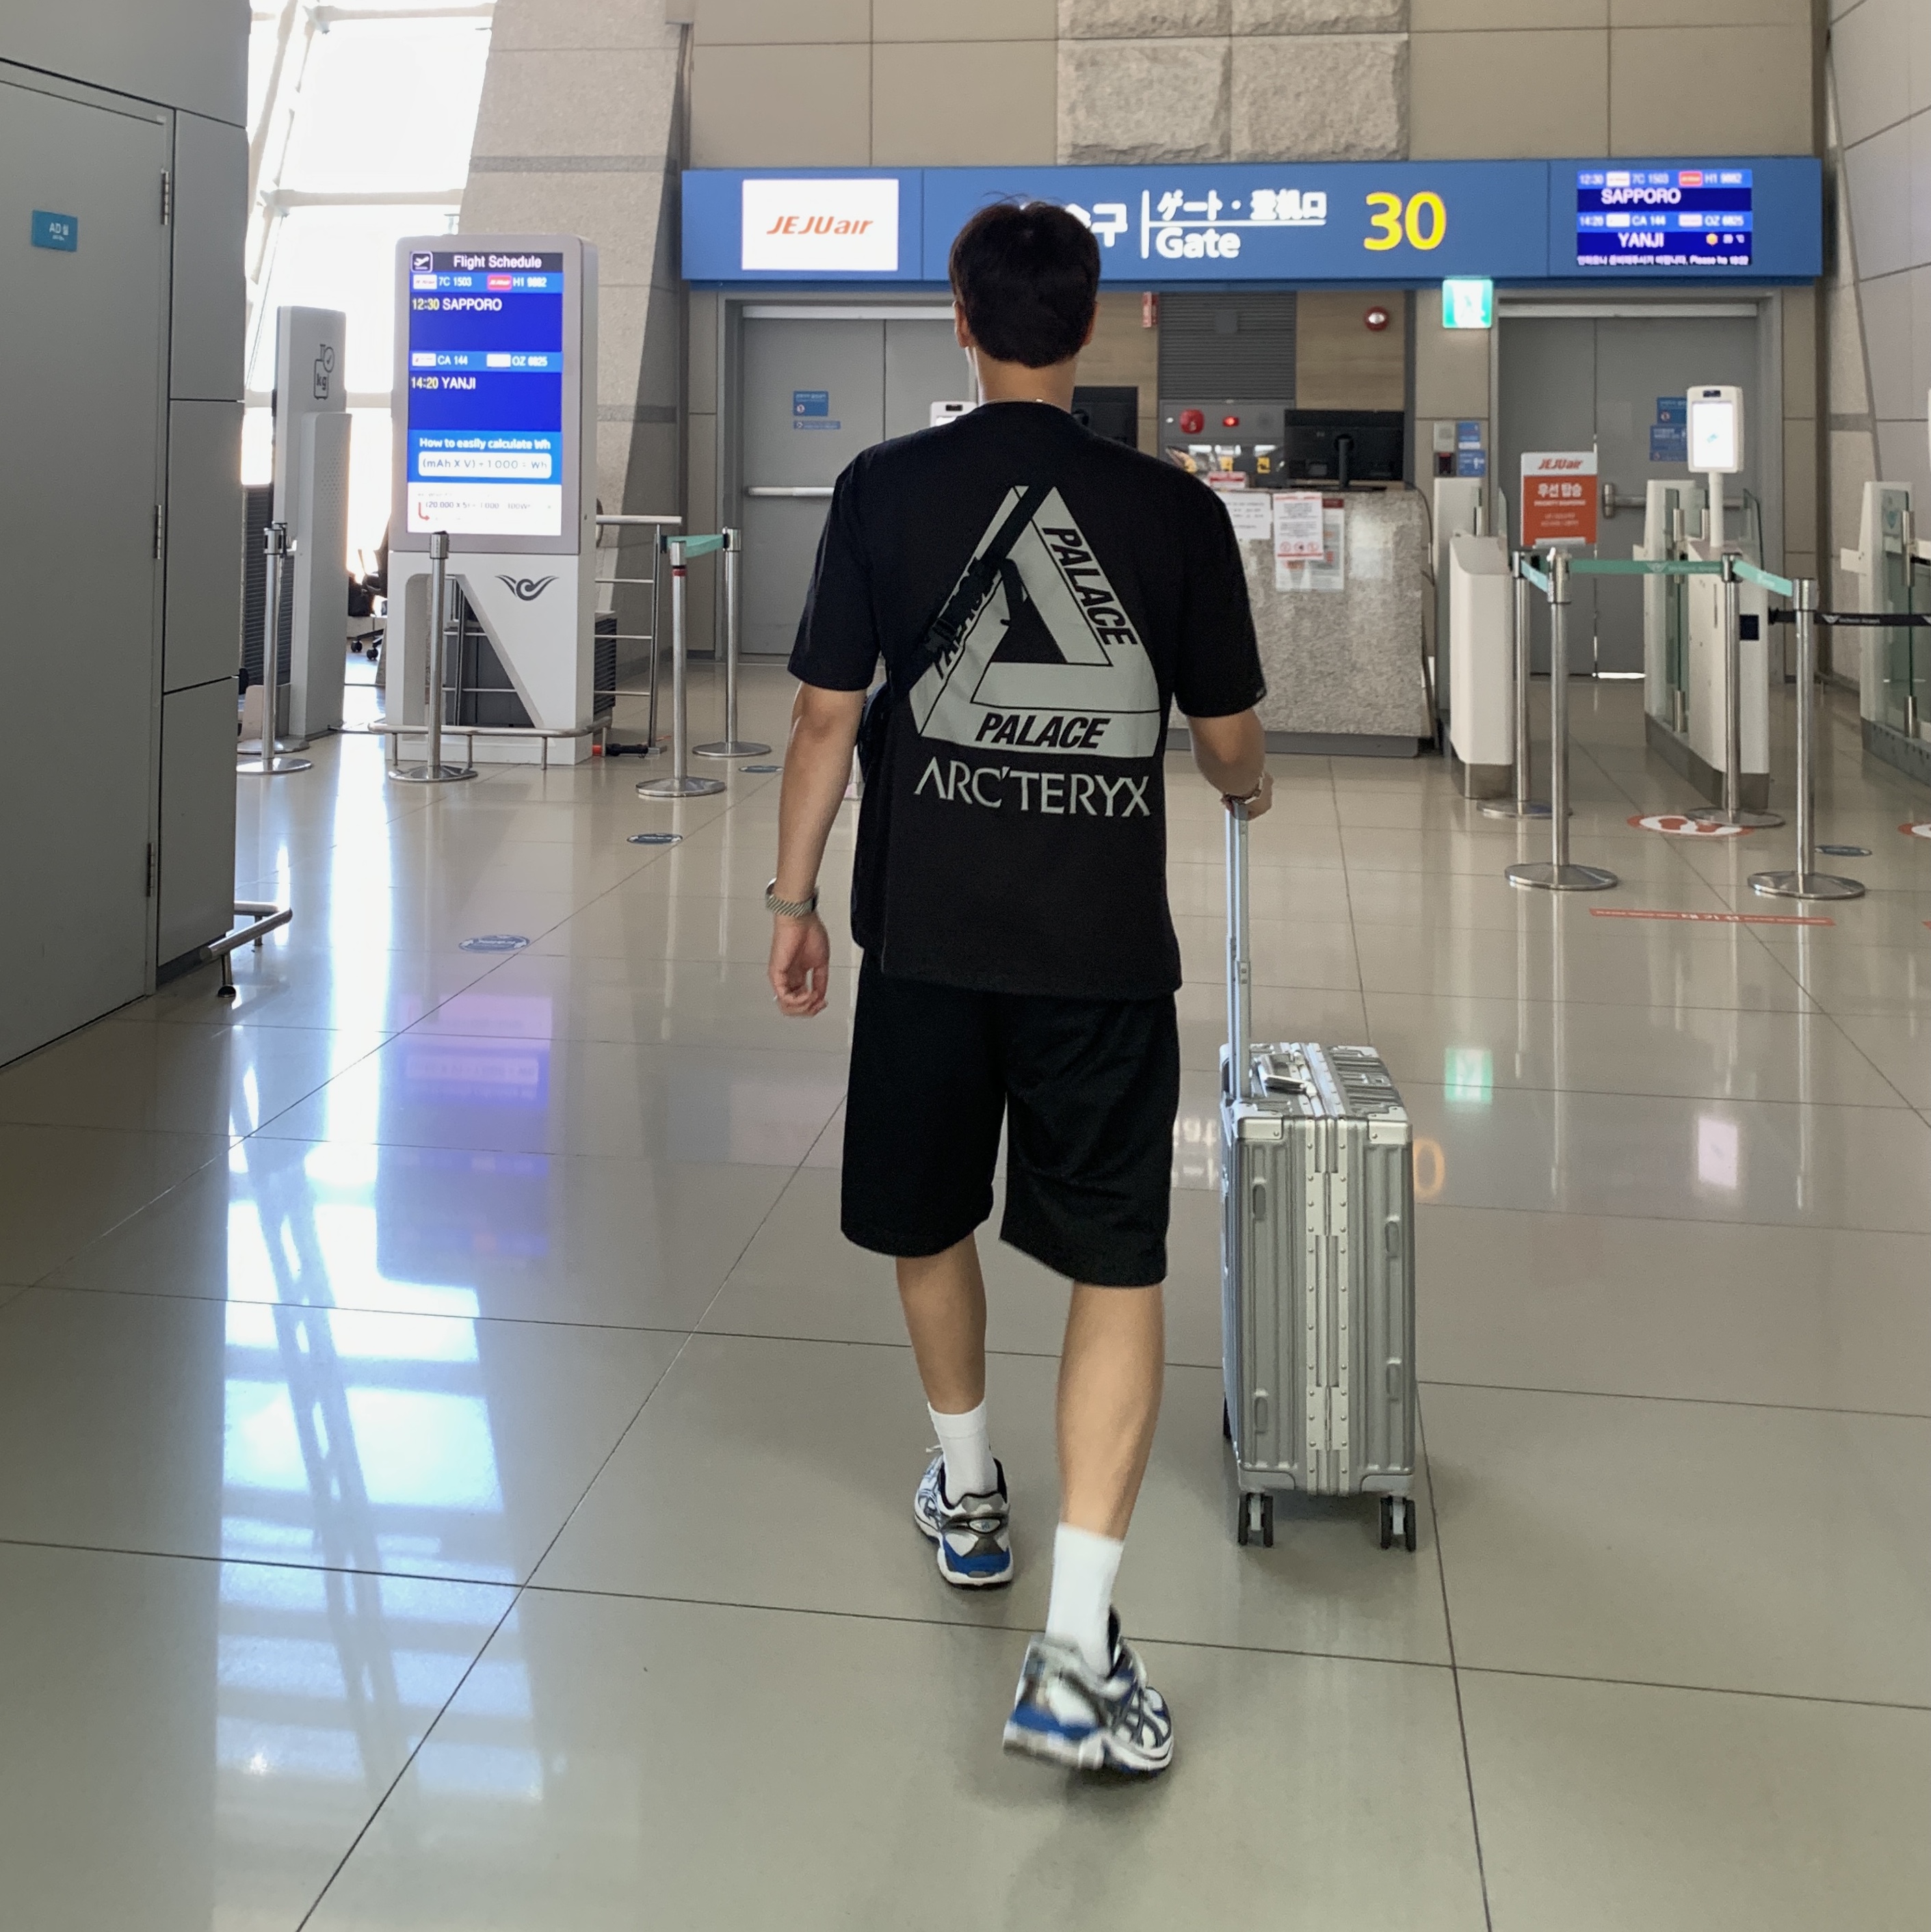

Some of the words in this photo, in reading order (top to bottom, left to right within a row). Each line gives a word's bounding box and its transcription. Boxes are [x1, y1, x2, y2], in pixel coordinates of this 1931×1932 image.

[1601, 187, 1681, 204] SAPPORO
[766, 215, 873, 235] JEJUair
[1364, 191, 1447, 250] 30
[1632, 215, 1647, 226] CA
[1156, 226, 1241, 259] Gate
[1618, 232, 1664, 248] YANJI
[454, 255, 486, 270] Flight
[488, 255, 542, 268] Schedule
[438, 276, 450, 287] 7C
[412, 298, 439, 310] 12:30
[443, 298, 503, 310] SAPPORO
[438, 355, 451, 365] CA
[454, 355, 468, 365] 144
[512, 356, 525, 367] OZ
[317, 373, 327, 391] kg
[411, 377, 438, 389] 14:20
[442, 377, 476, 389] YANJI
[419, 438, 443, 447] How
[445, 438, 455, 448] to
[457, 438, 486, 450] easily
[488, 438, 532, 449] calculate
[534, 439, 551, 449] Wh
[423, 458, 451, 468] (mAh
[464, 459, 475, 468] V)
[531, 460, 547, 469] Wh
[1042, 527, 1138, 646] PALACE
[975, 712, 1111, 750] PALACE
[914, 756, 1151, 817] ARC'TERYX
